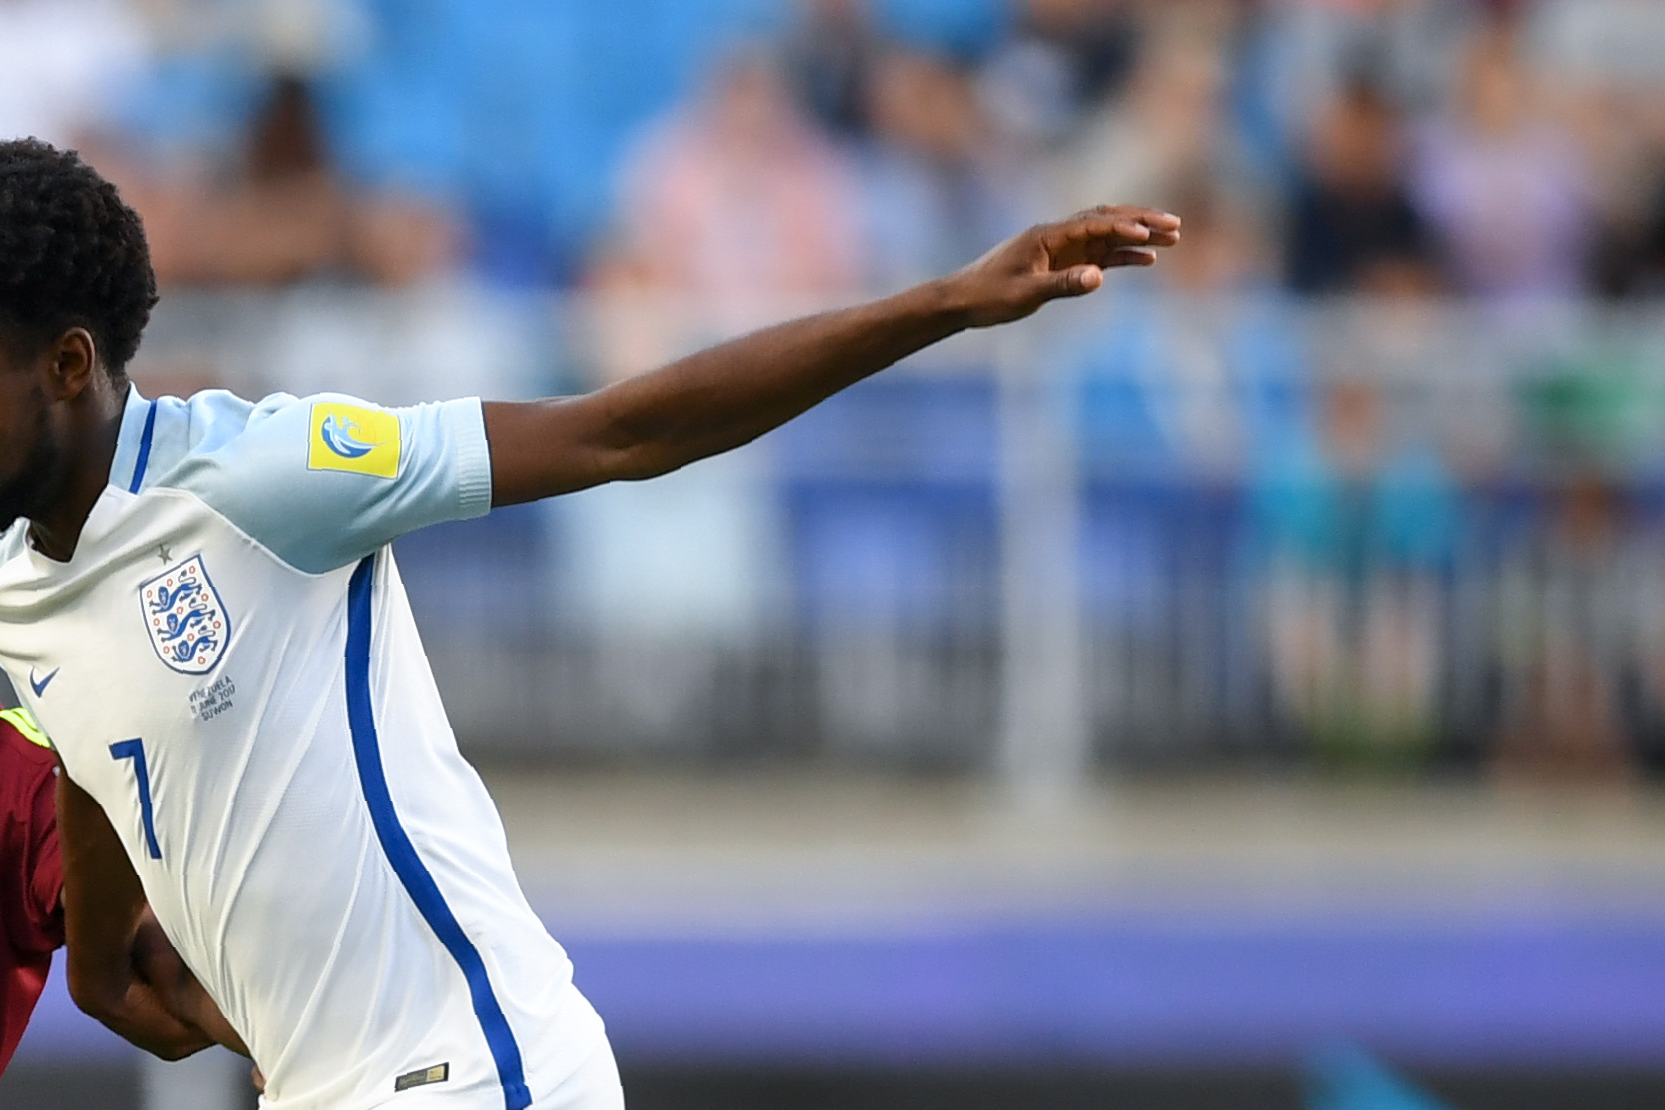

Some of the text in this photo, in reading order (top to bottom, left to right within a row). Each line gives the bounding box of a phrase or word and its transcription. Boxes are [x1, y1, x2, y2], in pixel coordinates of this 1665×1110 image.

[199, 695, 217, 711] JUNE
[218, 684, 236, 701] 2017
[201, 699, 233, 721] SUWON
[108, 737, 162, 859] 7
